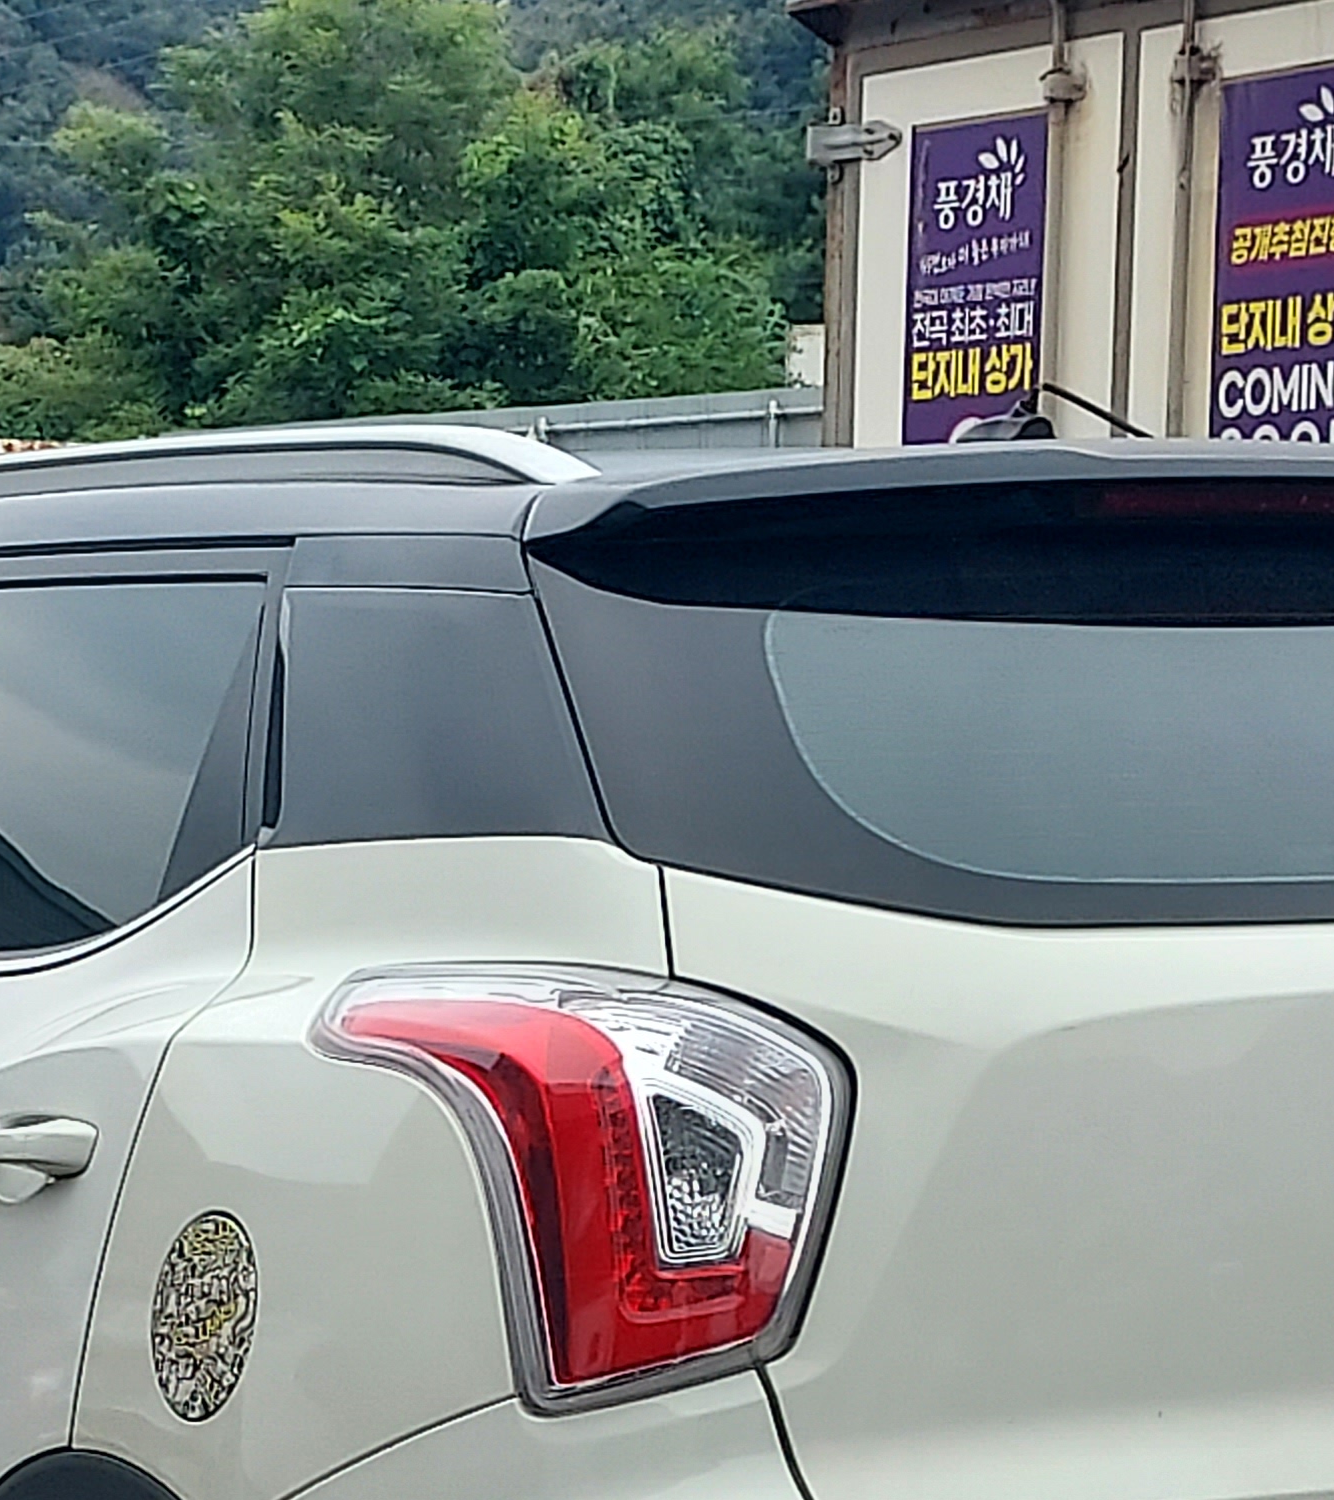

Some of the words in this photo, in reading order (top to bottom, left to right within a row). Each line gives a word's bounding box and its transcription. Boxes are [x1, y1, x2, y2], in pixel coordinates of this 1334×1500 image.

[932, 171, 1012, 230] 풍경채
[911, 310, 948, 348] 전곡
[1221, 295, 1302, 355] 단지내
[911, 346, 981, 401] 단지내
[984, 341, 1033, 395] 상가
